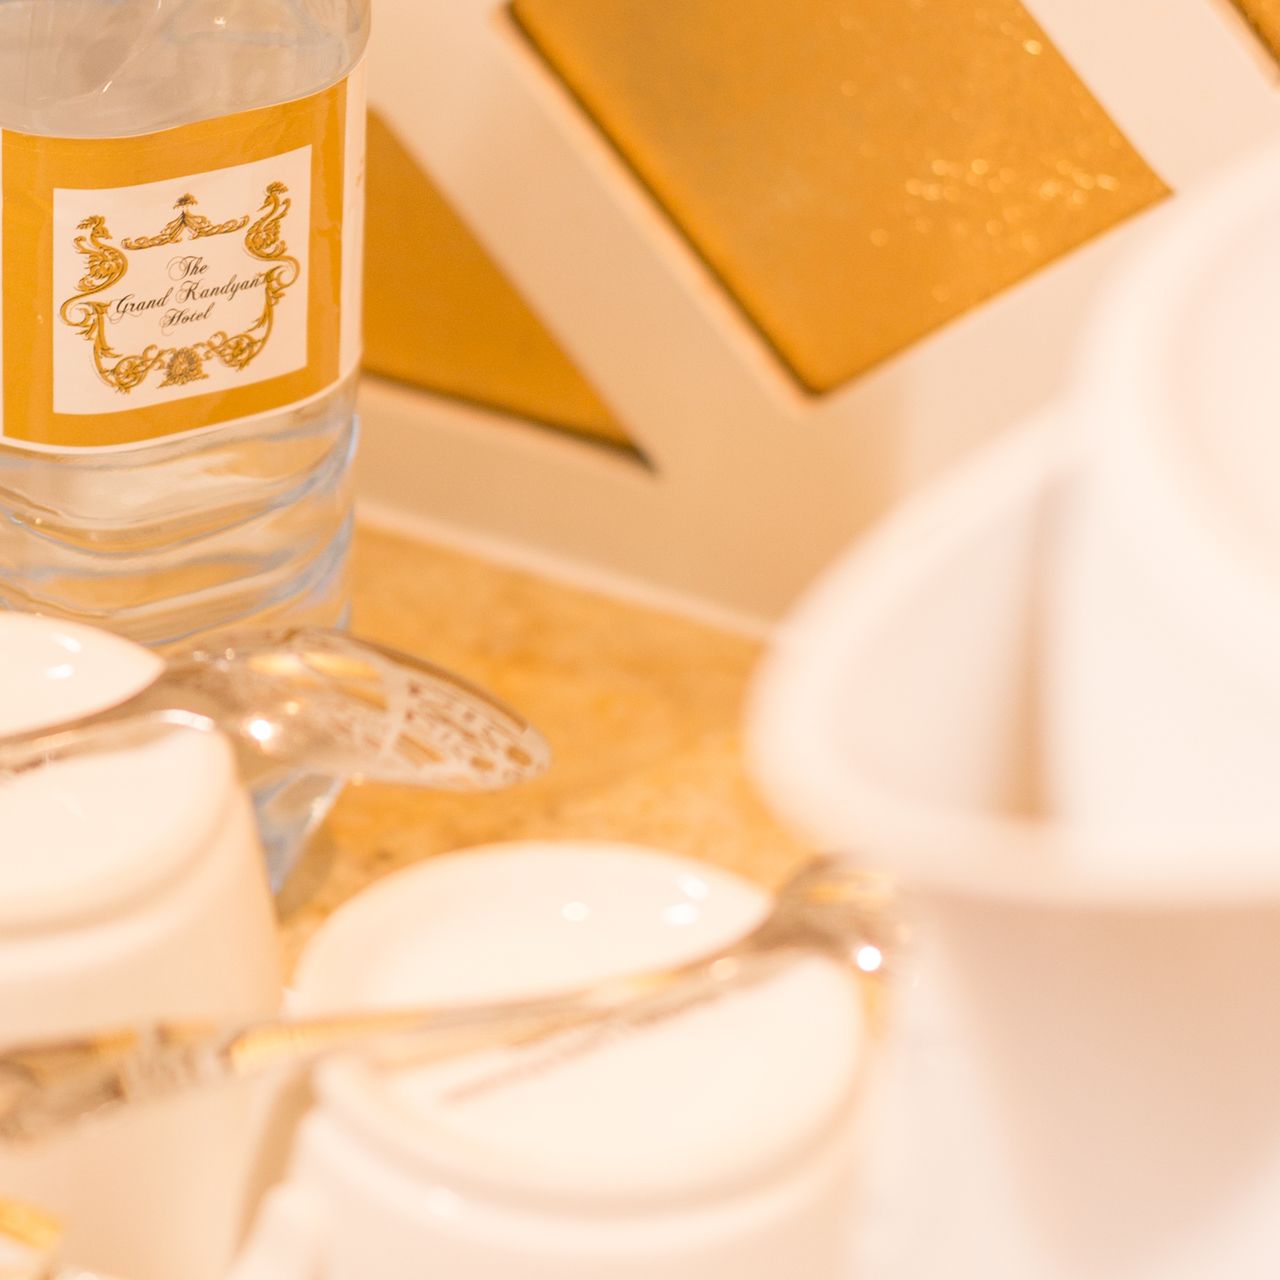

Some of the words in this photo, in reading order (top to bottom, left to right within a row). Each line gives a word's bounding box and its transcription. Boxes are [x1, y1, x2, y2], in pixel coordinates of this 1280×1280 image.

[166, 255, 208, 281] The
[107, 287, 173, 324] Grand
[160, 301, 216, 336] Hotel
